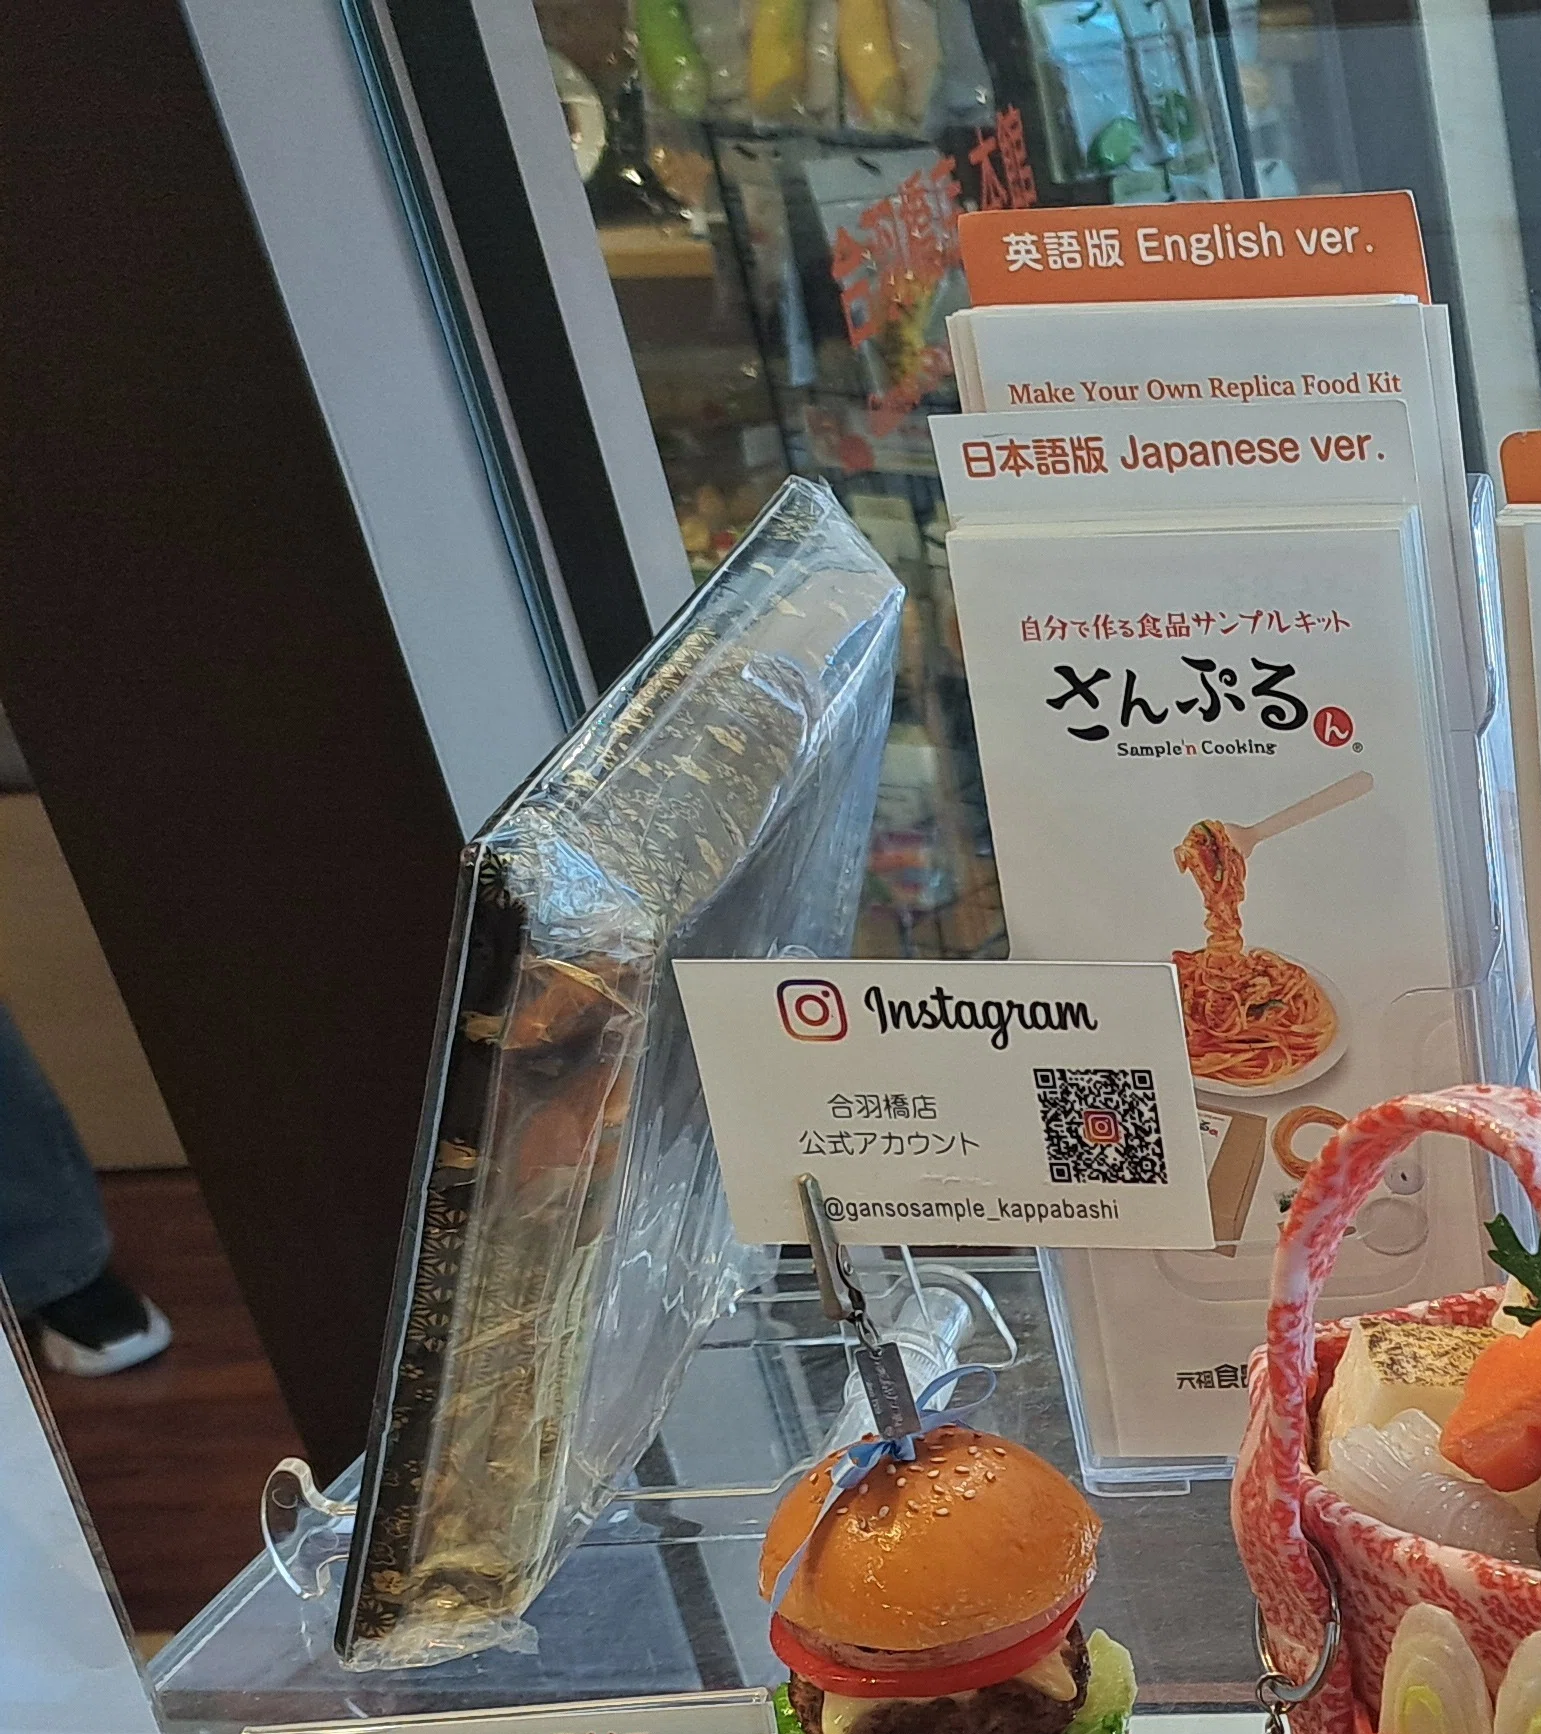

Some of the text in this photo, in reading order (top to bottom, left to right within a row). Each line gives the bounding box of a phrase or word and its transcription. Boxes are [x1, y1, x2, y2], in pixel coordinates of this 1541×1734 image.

[1004, 221, 1376, 270] 英語版 English ver.
[1009, 370, 1402, 405] Make Your Own Replica Food Kit
[962, 433, 1386, 478] 日本語版 Japanese ver.
[1020, 610, 1352, 643] 自分で作る食品サンプルキット
[1046, 655, 1309, 740] さんぷる
[1201, 740, 1277, 758] Cooking
[864, 985, 1098, 1050] Instagram
[827, 1093, 938, 1122] 合羽橋店
[800, 1130, 981, 1157] 公式アカウント
[822, 1196, 1119, 1223] @gansosample_kappabashi
